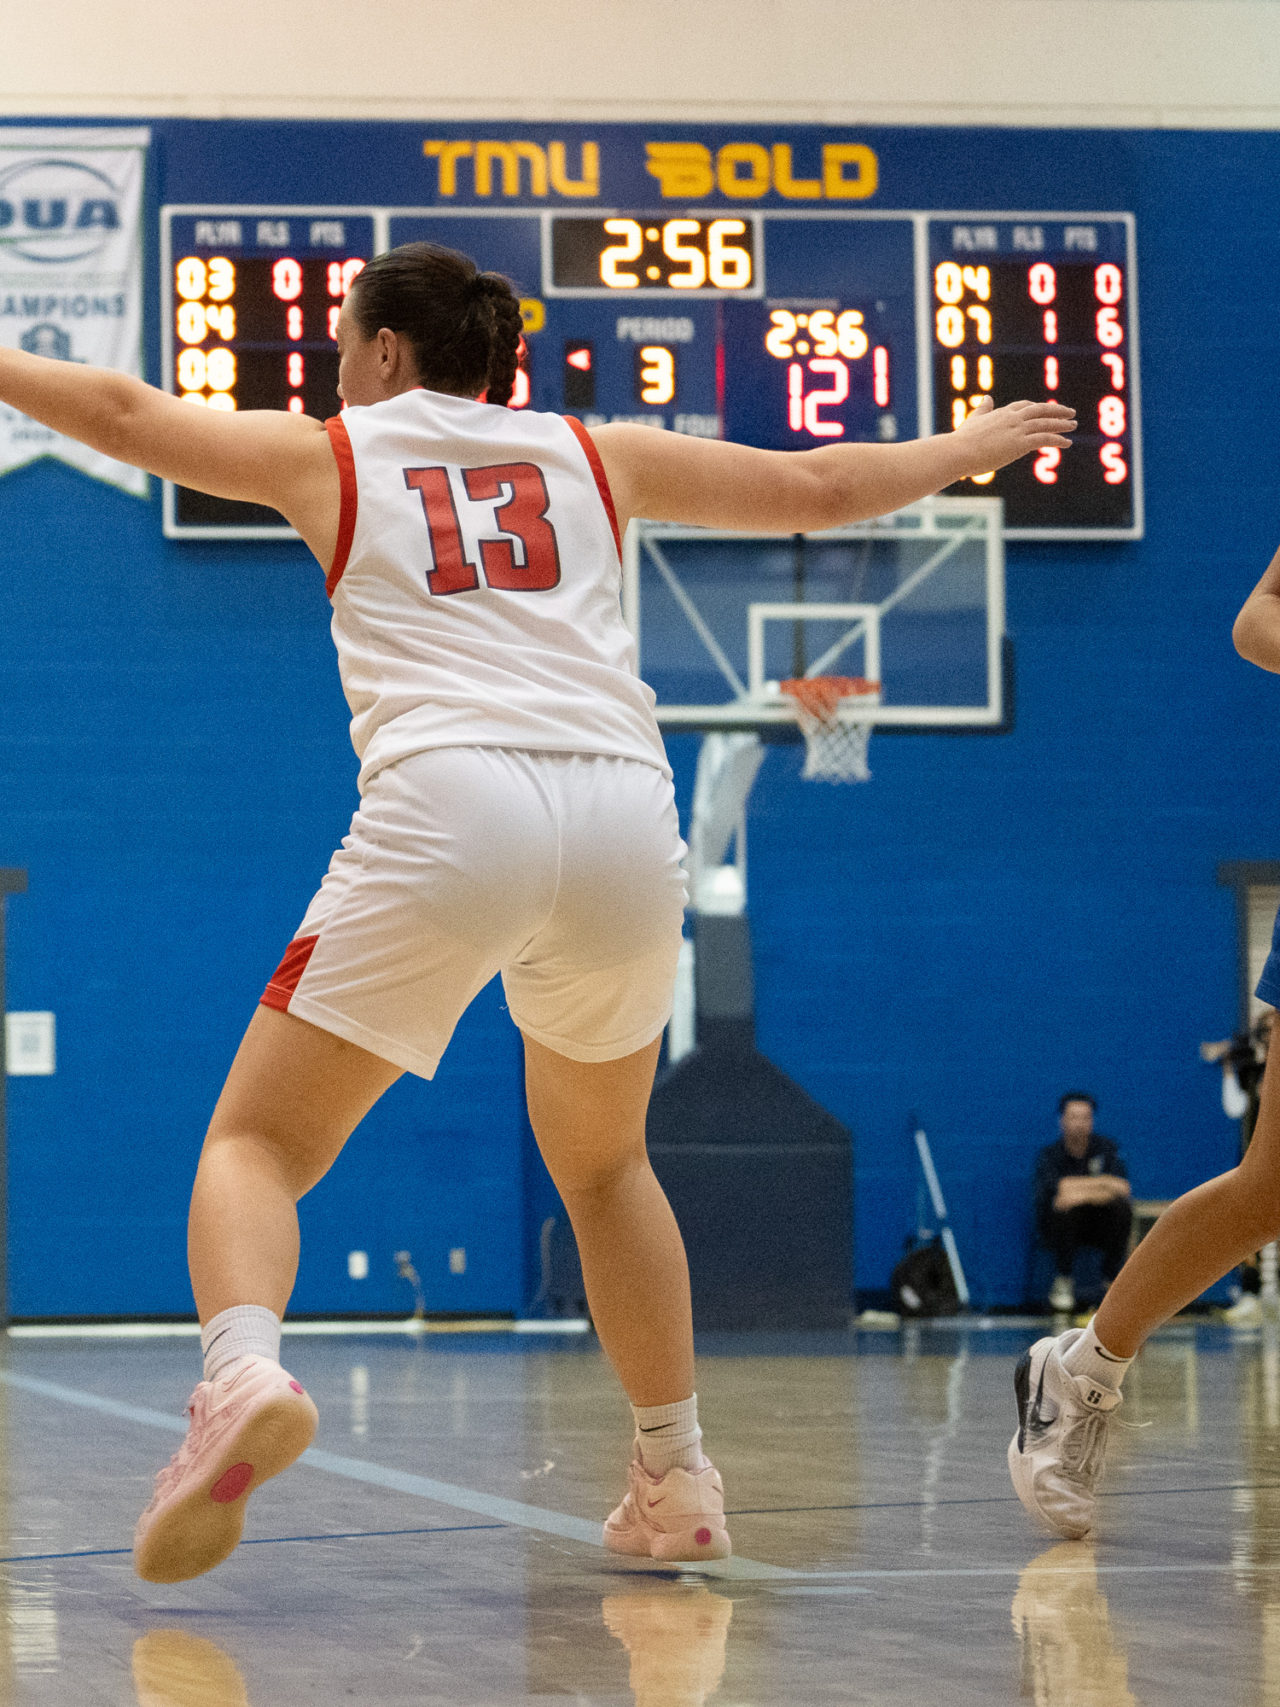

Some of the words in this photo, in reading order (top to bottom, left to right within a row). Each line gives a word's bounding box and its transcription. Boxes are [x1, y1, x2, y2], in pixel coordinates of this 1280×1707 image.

[423, 141, 599, 197] TMU
[646, 142, 877, 199] BOLD
[600, 218, 751, 289] 2:56
[176, 256, 235, 300] 03
[273, 258, 302, 300] 0
[935, 262, 990, 304] 04
[1028, 263, 1056, 304] 0
[1095, 263, 1122, 304] 0
[176, 300, 236, 344] 04
[288, 306, 303, 340] 1
[617, 317, 694, 341] PERIOD
[765, 310, 868, 358] 2:56
[935, 304, 992, 347] 07
[1043, 309, 1058, 344] 1
[1096, 306, 1123, 347] 6
[288, 352, 304, 388] 1
[640, 346, 674, 404] 3
[951, 354, 993, 391] 11
[1044, 355, 1059, 390] 1
[1101, 352, 1124, 390] 7
[787, 358, 849, 436] 12
[1098, 395, 1125, 437] 8
[1099, 442, 1126, 484] 5
[403, 462, 561, 595] 13
